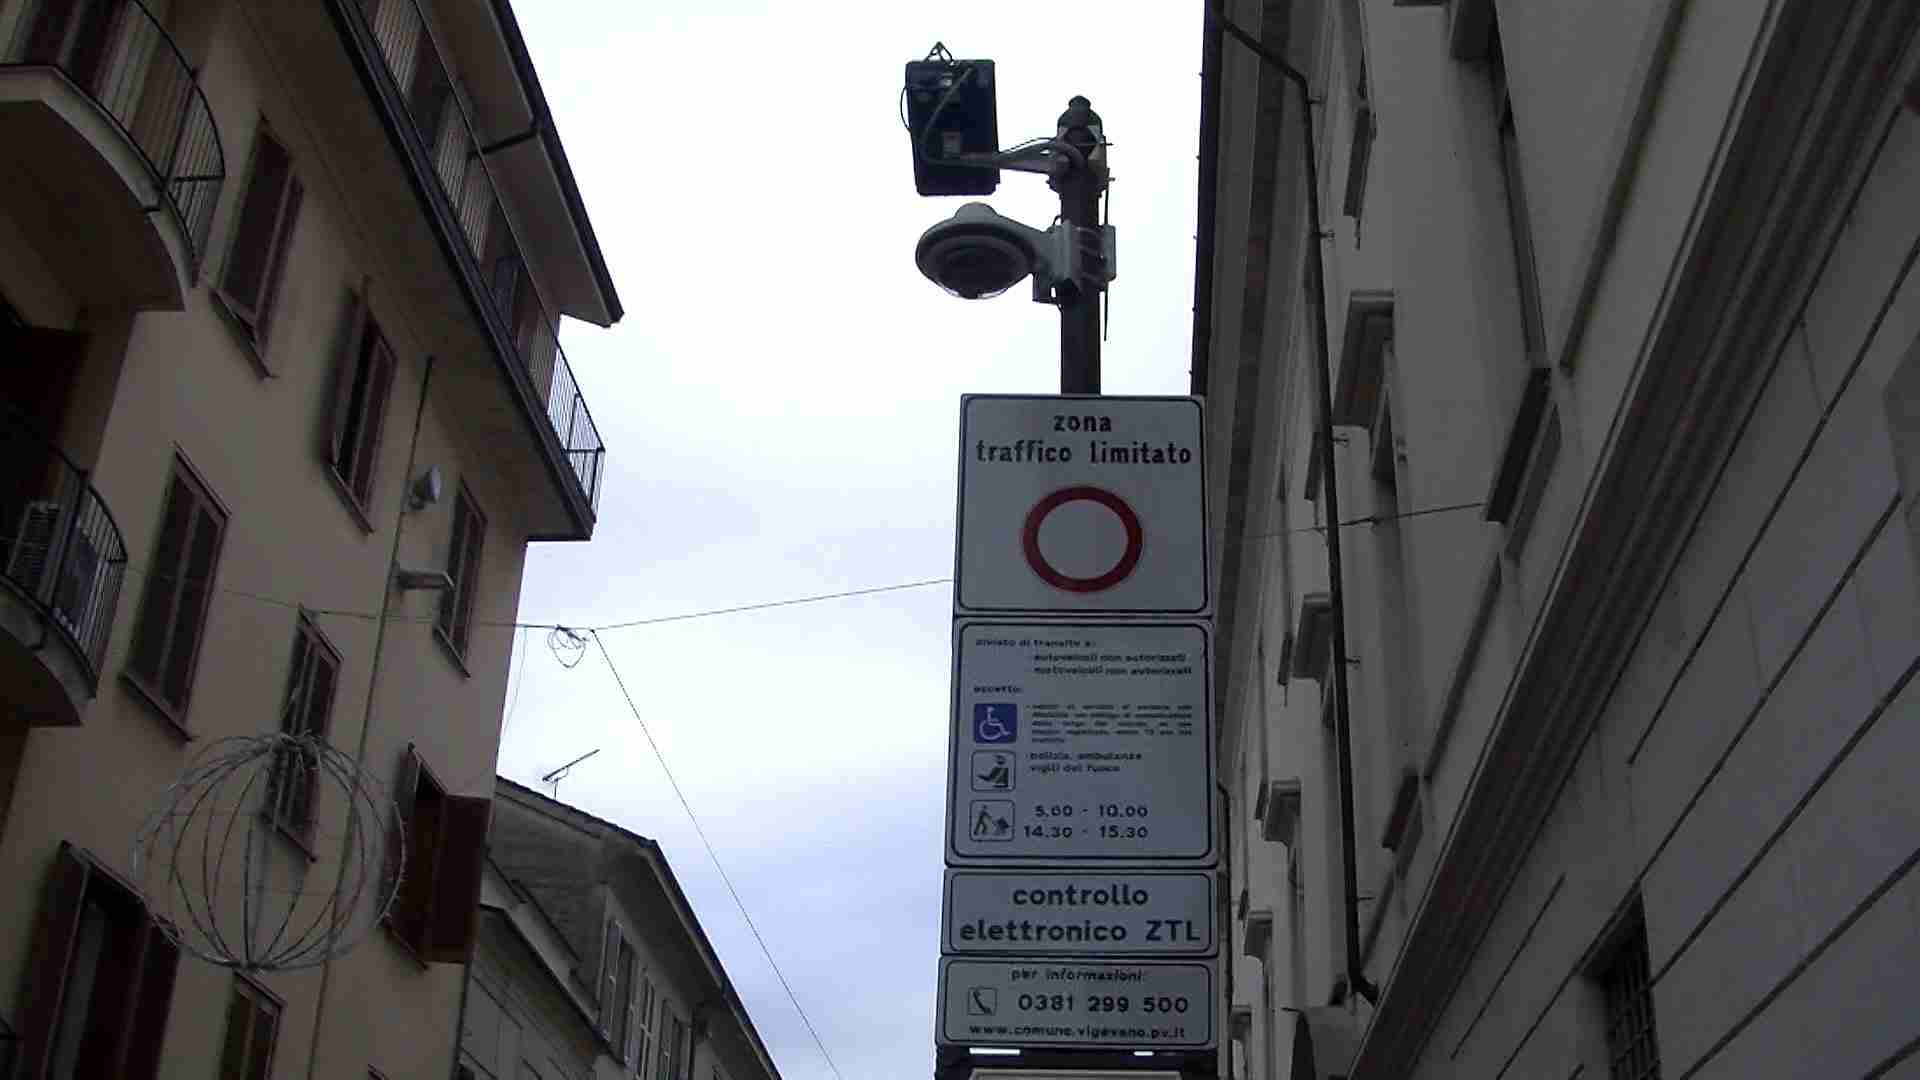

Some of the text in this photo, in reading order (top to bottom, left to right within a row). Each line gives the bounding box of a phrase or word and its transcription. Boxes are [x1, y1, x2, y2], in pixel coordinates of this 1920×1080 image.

[1053, 415, 1112, 432] zona
[976, 440, 1192, 465] traffico limitato
[1035, 804, 1073, 818] 5.00
[1099, 804, 1148, 818] 10.00
[1024, 825, 1073, 839] 14.30
[1099, 825, 1148, 839] 15.30
[1012, 884, 1149, 906] controllo
[959, 919, 1201, 942] elettronico ZTL
[1011, 967, 1037, 980] per
[1018, 994, 1188, 1014] 0381 299 500
